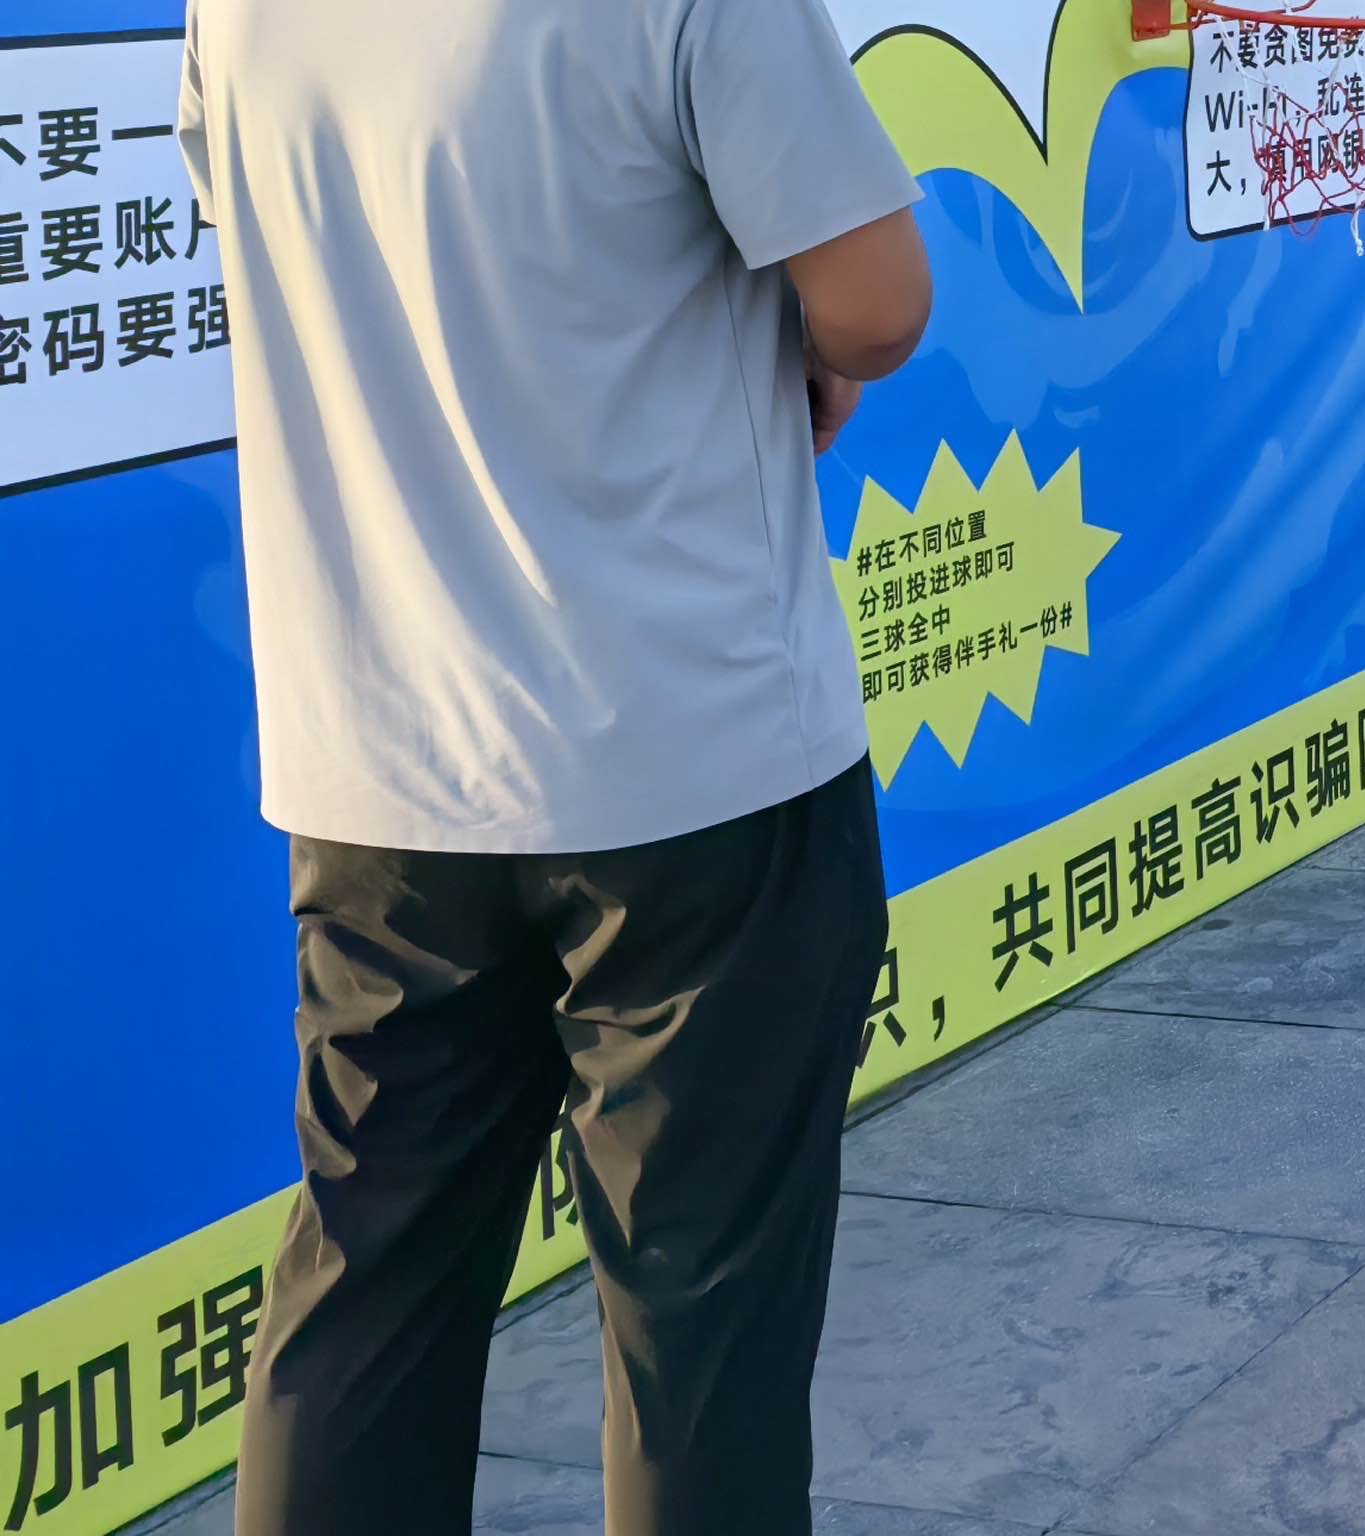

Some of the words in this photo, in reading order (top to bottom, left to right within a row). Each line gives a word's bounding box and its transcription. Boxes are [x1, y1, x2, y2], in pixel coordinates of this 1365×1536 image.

[856, 510, 988, 577] #在不同位置
[858, 541, 1016, 622] 分别投进球即可
[860, 604, 952, 663] 三球全中
[862, 601, 1074, 705] 即可获得伴手礼一份#
